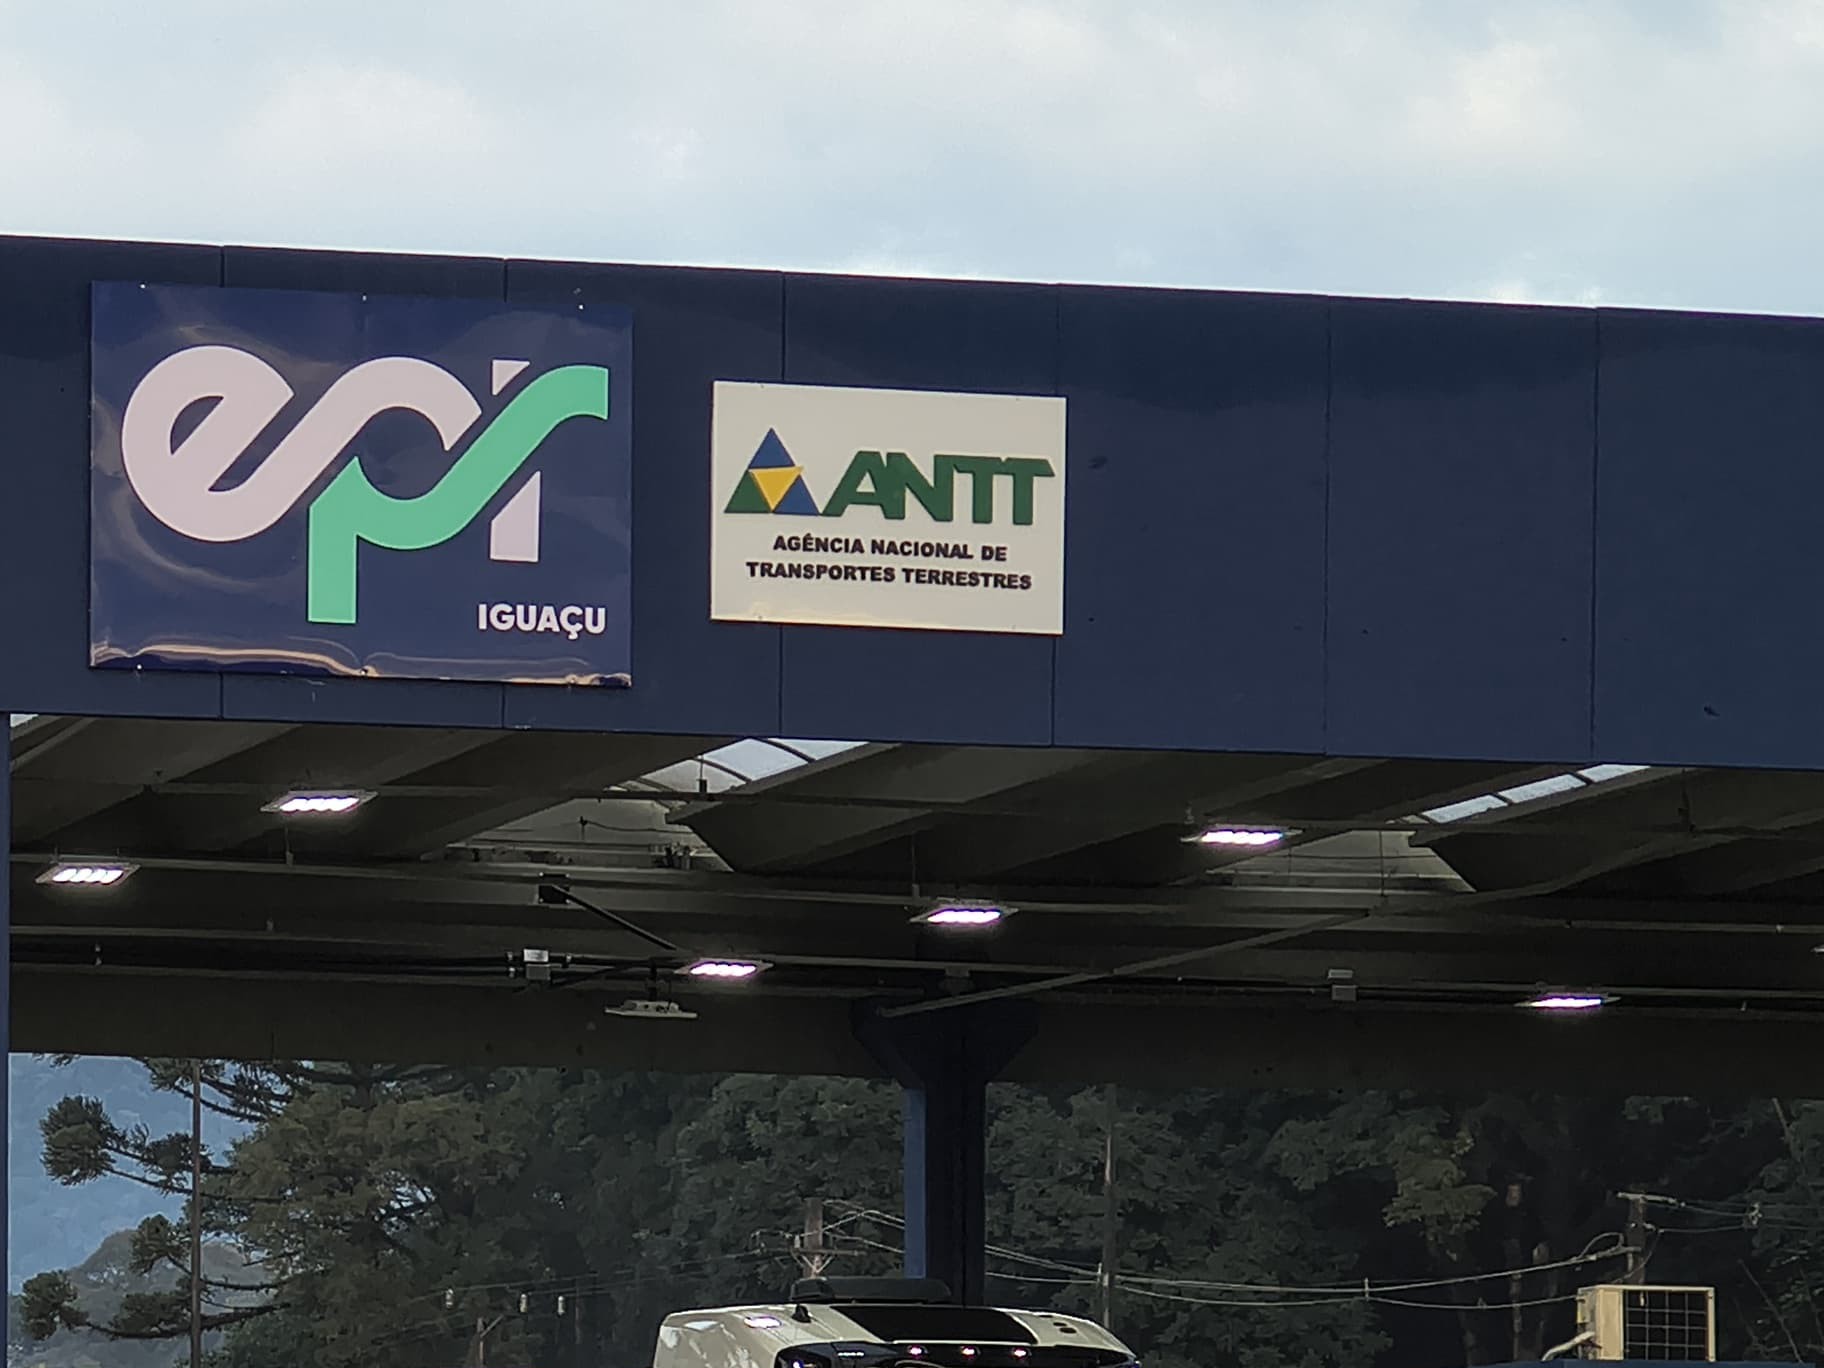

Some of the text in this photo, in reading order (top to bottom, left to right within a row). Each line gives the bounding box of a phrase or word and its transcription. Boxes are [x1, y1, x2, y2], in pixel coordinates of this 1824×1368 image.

[822, 451, 1054, 525] ANTT
[773, 532, 1007, 562] AGÊNCIA NACIONAL DE
[746, 561, 1032, 590] TRANSPORTES TERRESTRES
[478, 603, 607, 640] IGUAÇU
